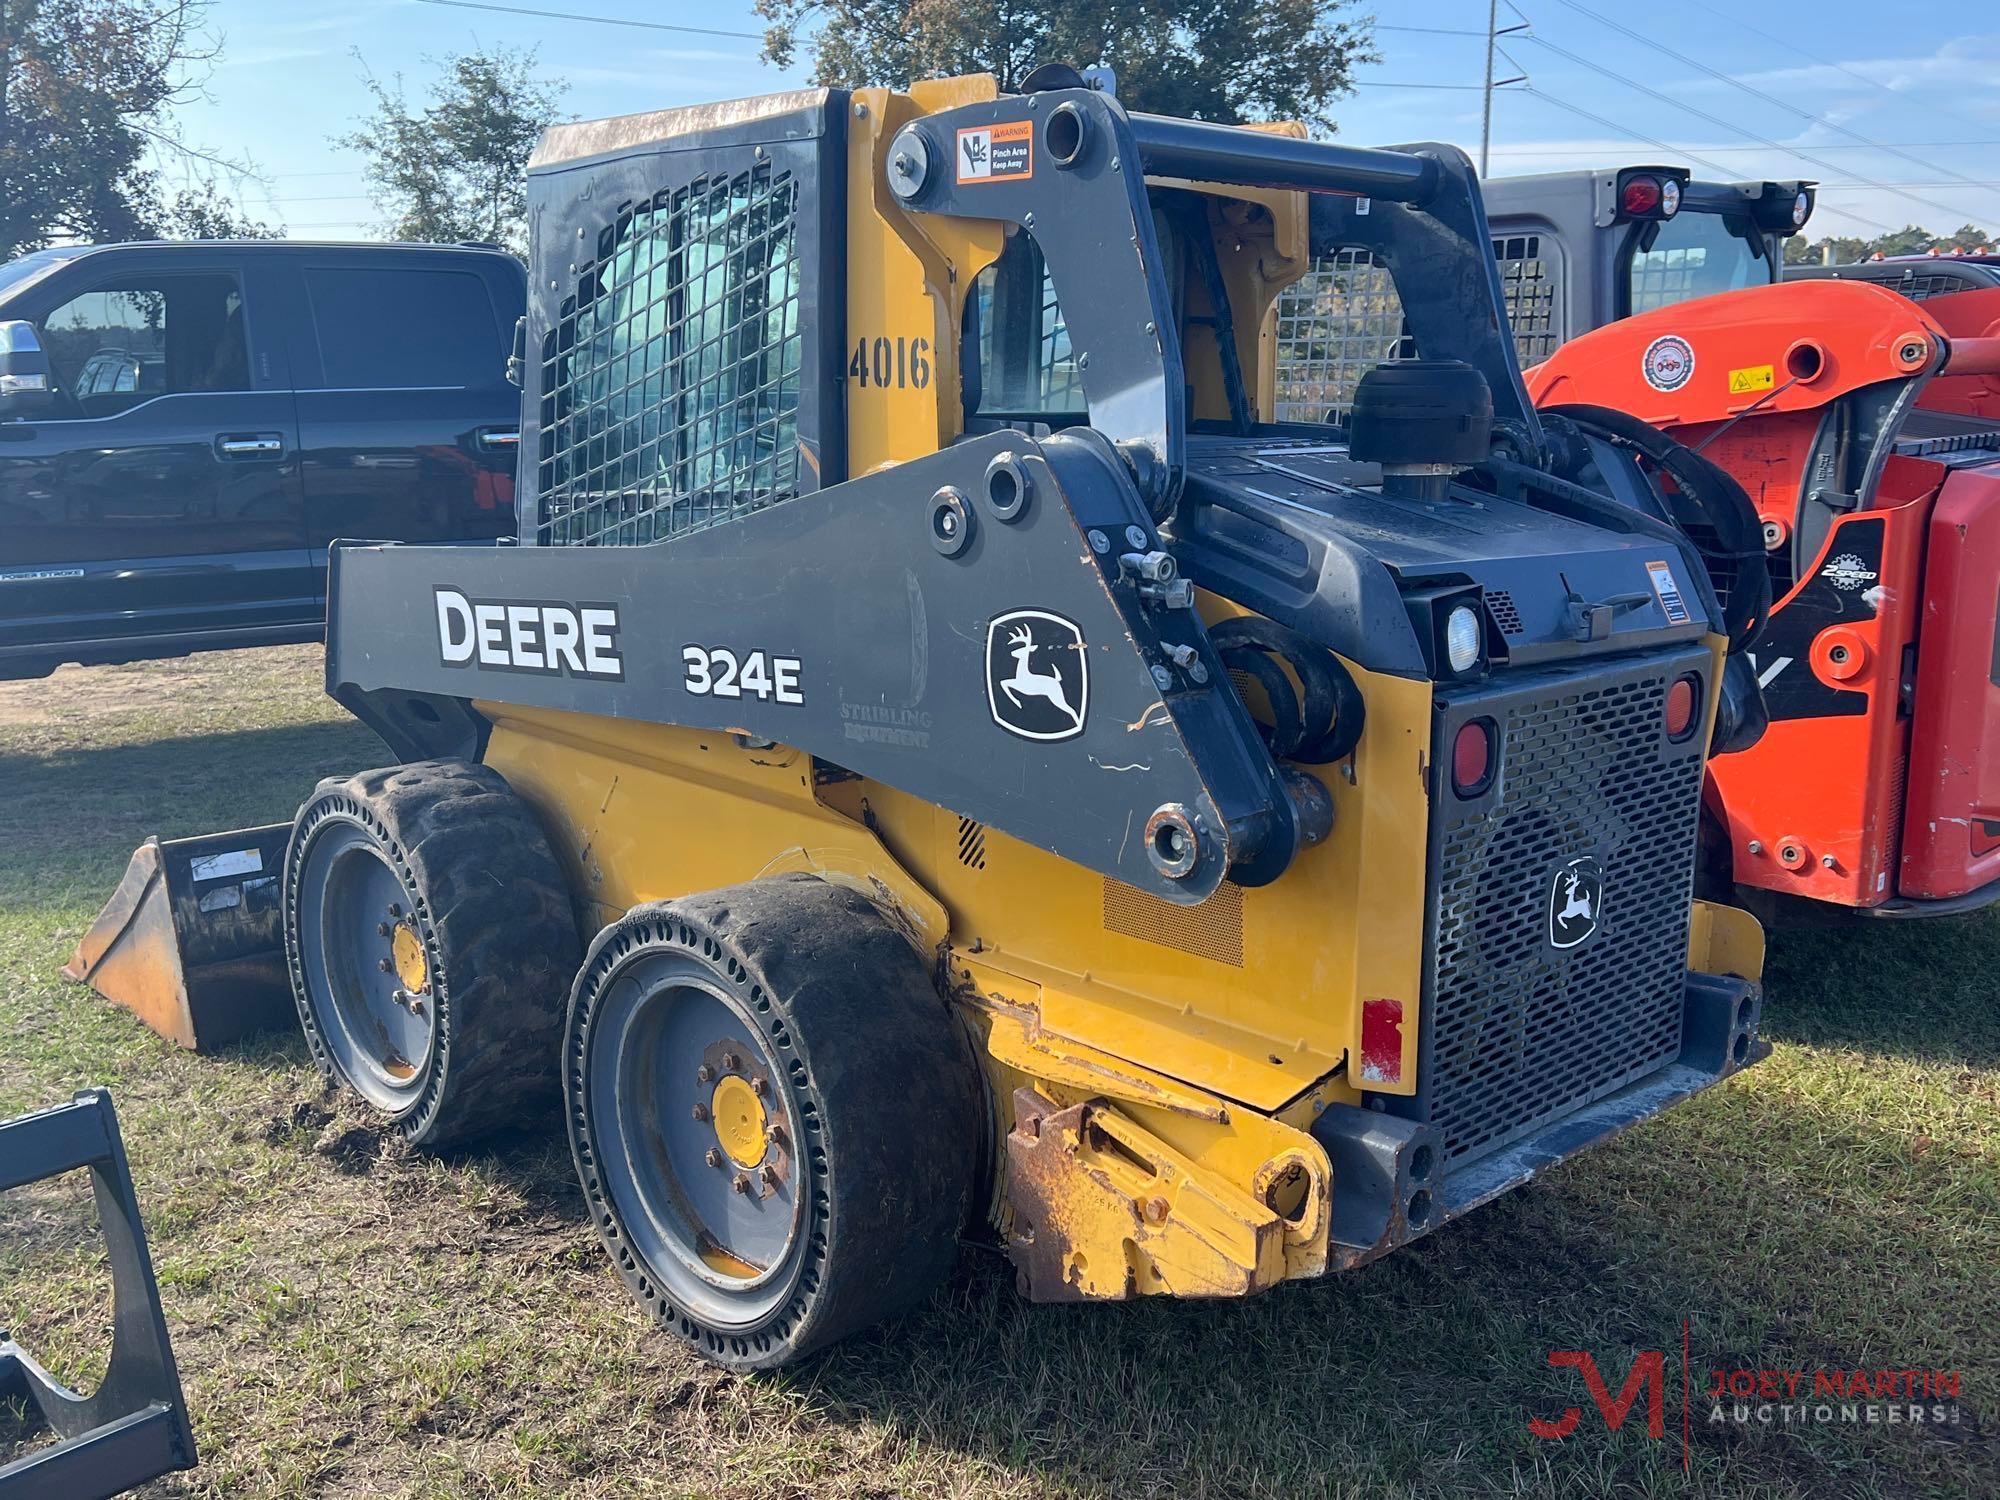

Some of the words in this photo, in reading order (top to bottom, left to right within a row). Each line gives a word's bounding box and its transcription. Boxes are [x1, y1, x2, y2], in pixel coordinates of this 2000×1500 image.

[1000, 127, 1028, 137] WARNING
[993, 148, 1011, 158] Pinch
[1012, 147, 1027, 157] Area
[993, 161, 1007, 170] Keep
[1008, 160, 1023, 168] Away
[850, 337, 930, 389] 4016
[436, 591, 621, 674] DEERE
[682, 647, 803, 704] 324E
[840, 702, 933, 729] STRIBLING
